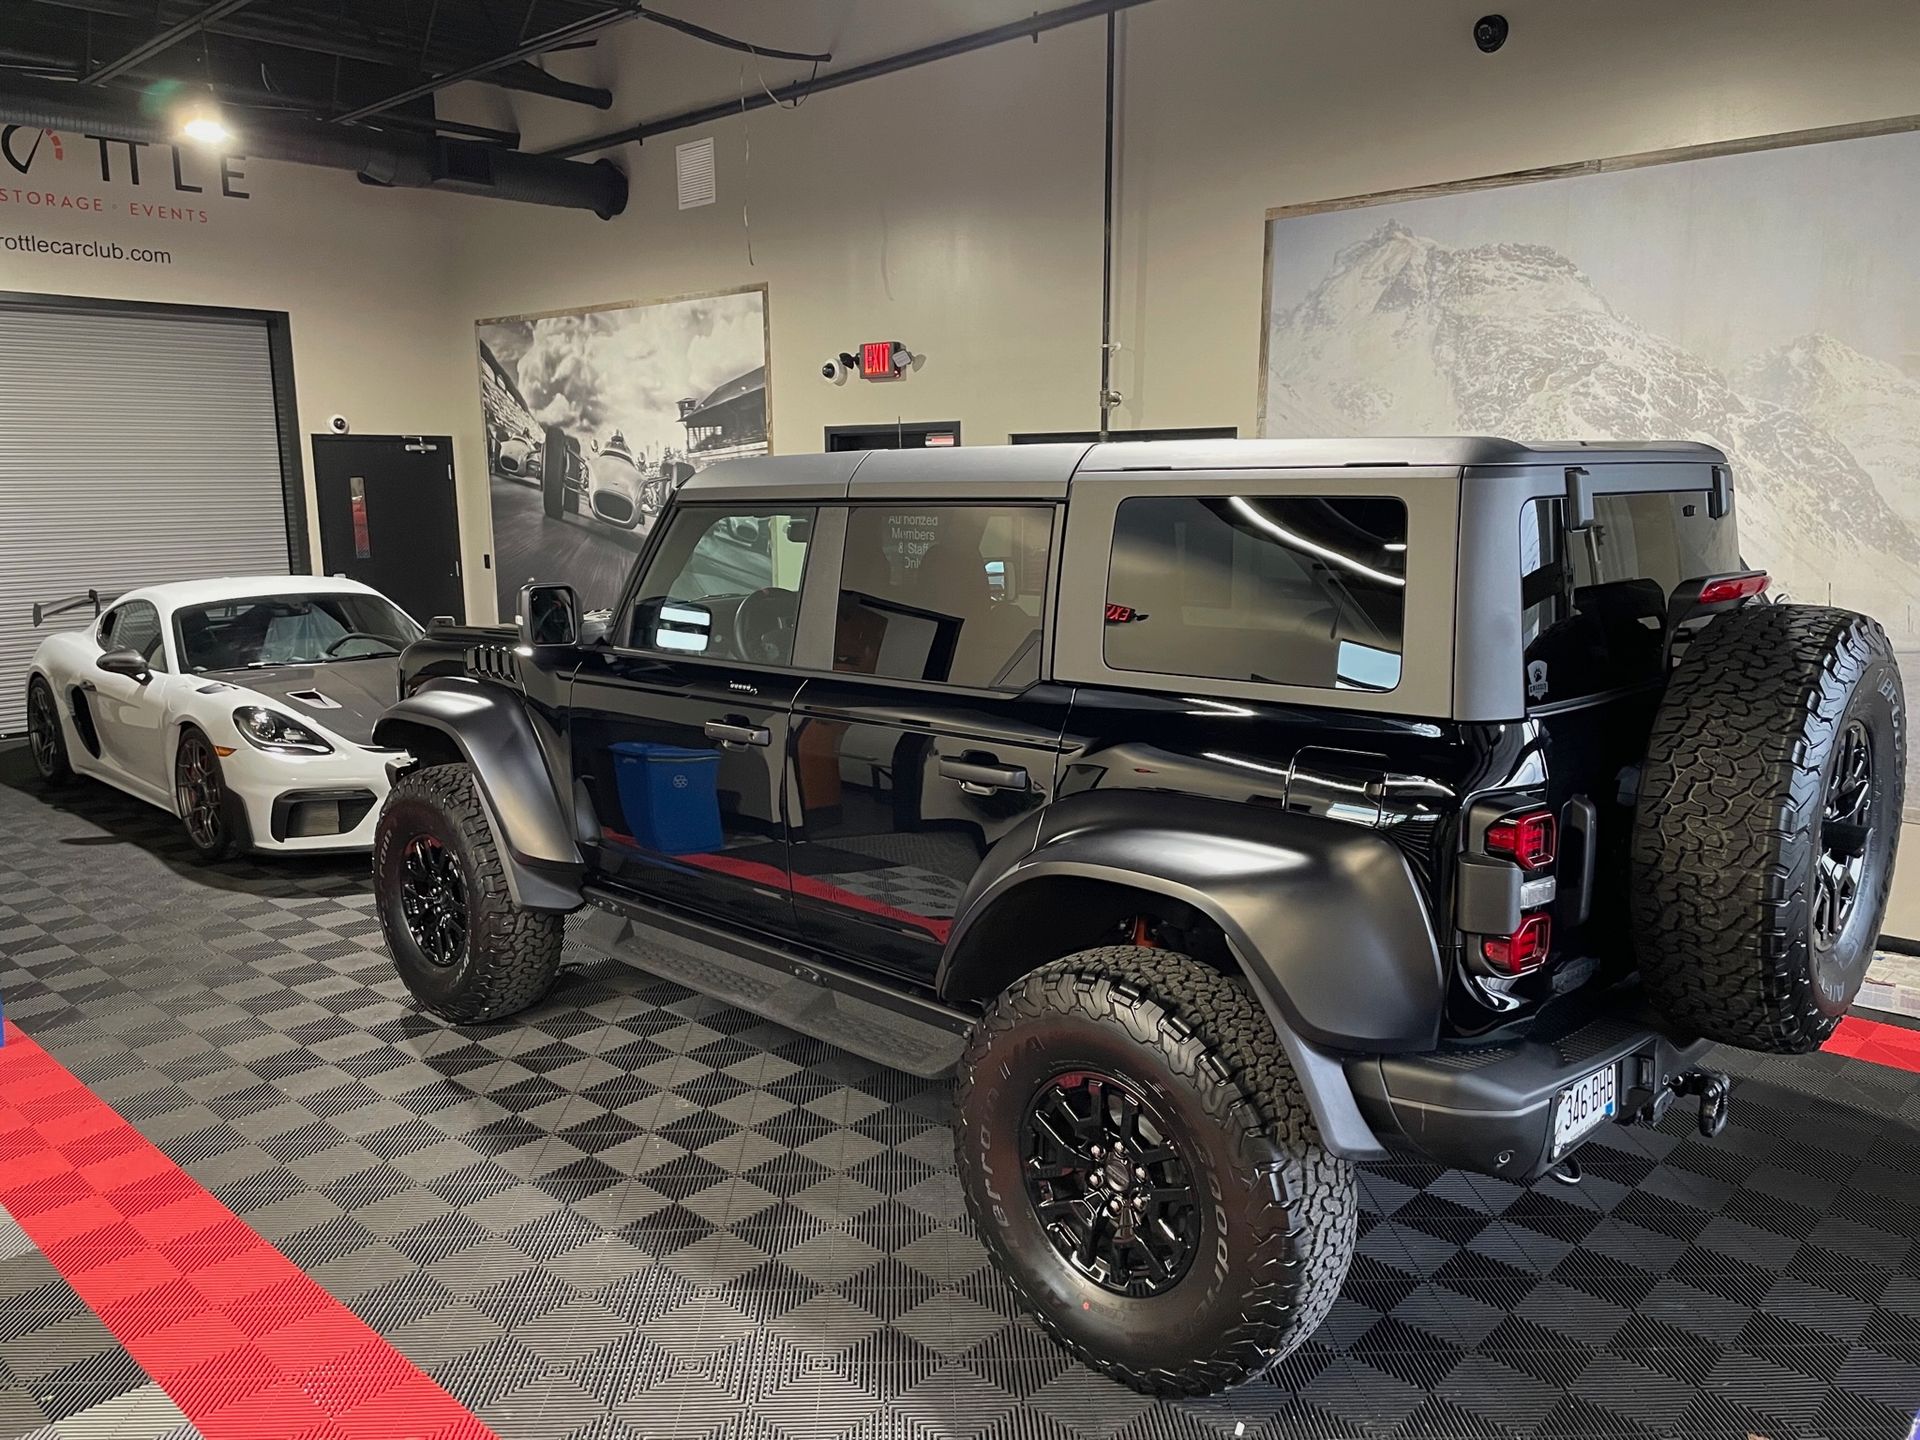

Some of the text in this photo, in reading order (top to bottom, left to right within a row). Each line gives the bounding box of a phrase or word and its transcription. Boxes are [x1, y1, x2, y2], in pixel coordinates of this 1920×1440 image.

[0, 188, 209, 224] STORAGE EVENTS
[864, 343, 890, 373] EXIT
[904, 555, 922, 569] Onl
